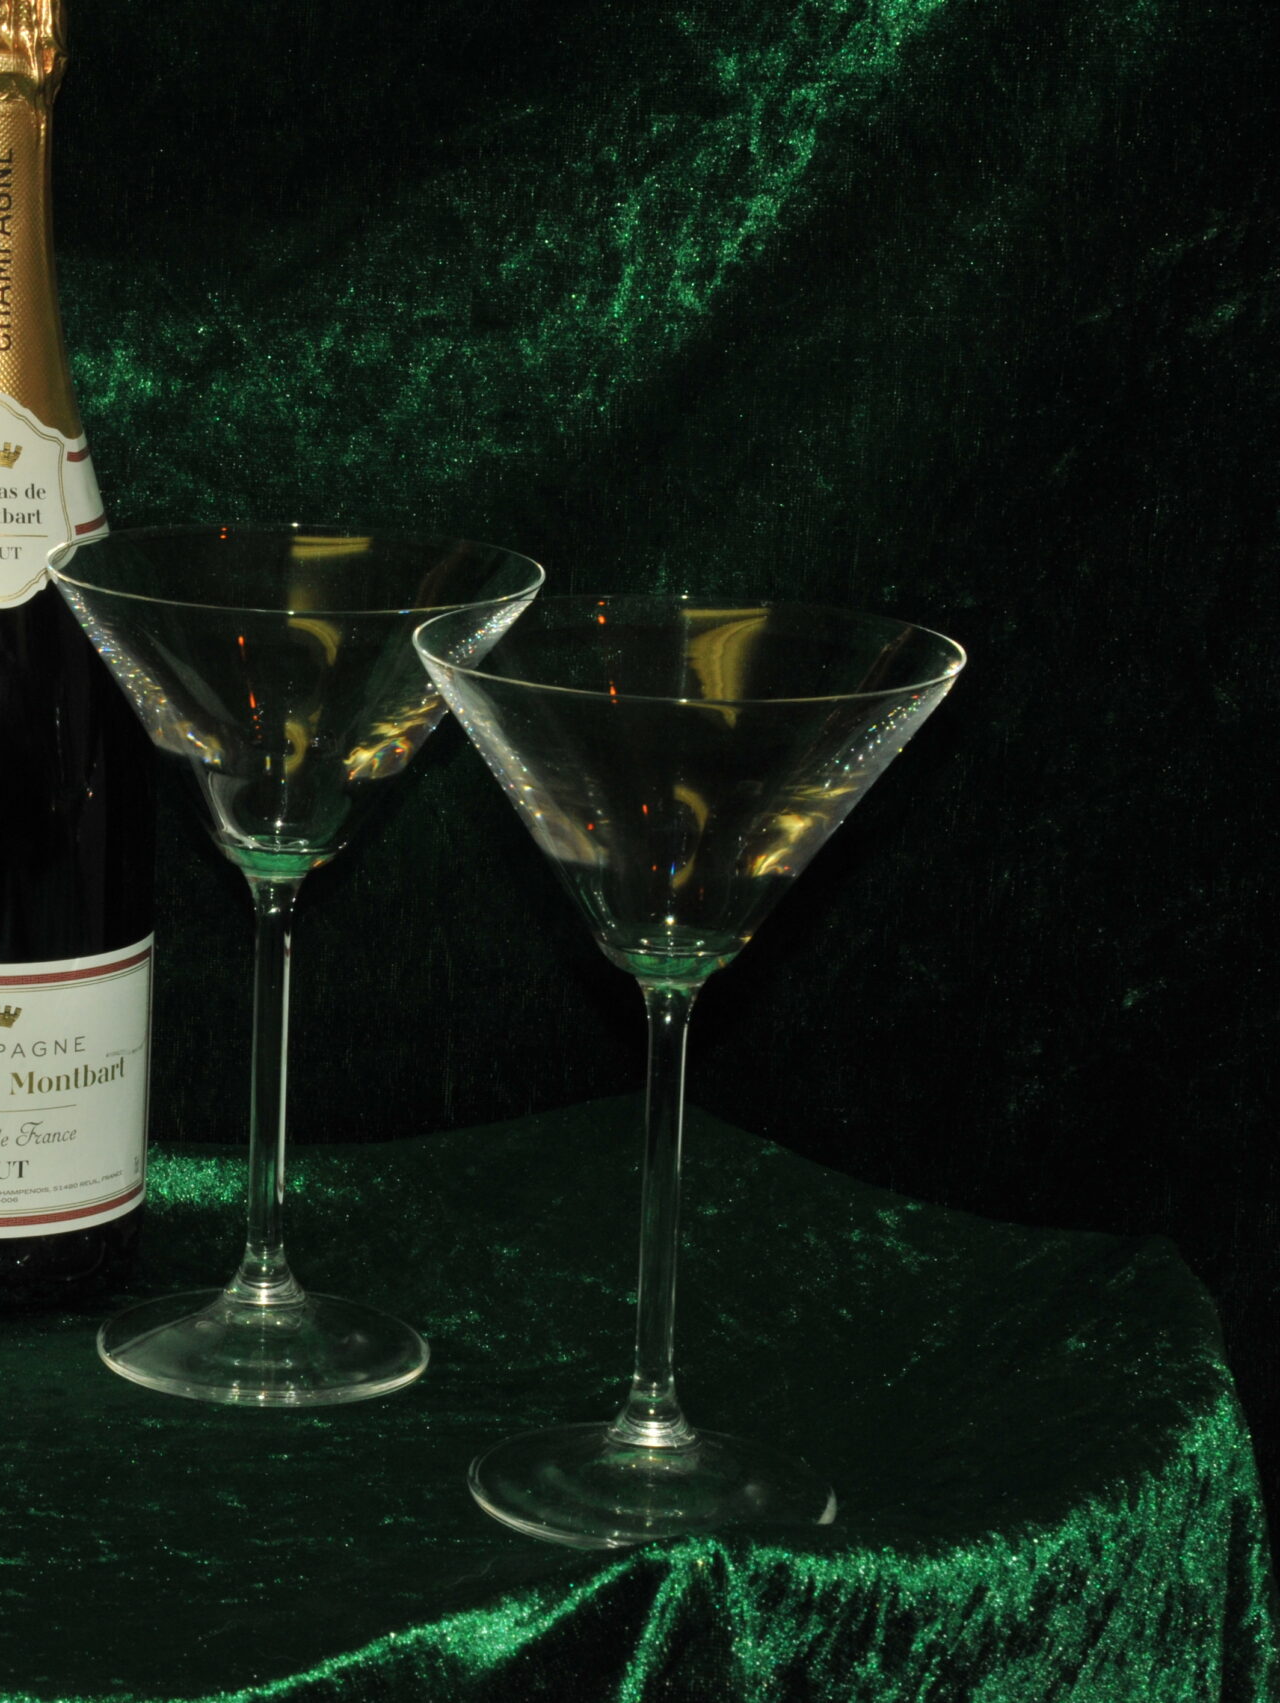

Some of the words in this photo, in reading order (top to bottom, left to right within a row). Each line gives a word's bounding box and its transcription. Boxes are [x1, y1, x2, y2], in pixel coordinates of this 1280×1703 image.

[25, 484, 47, 500] de
[9, 1056, 125, 1096] Montbart
[15, 1121, 78, 1148] France
